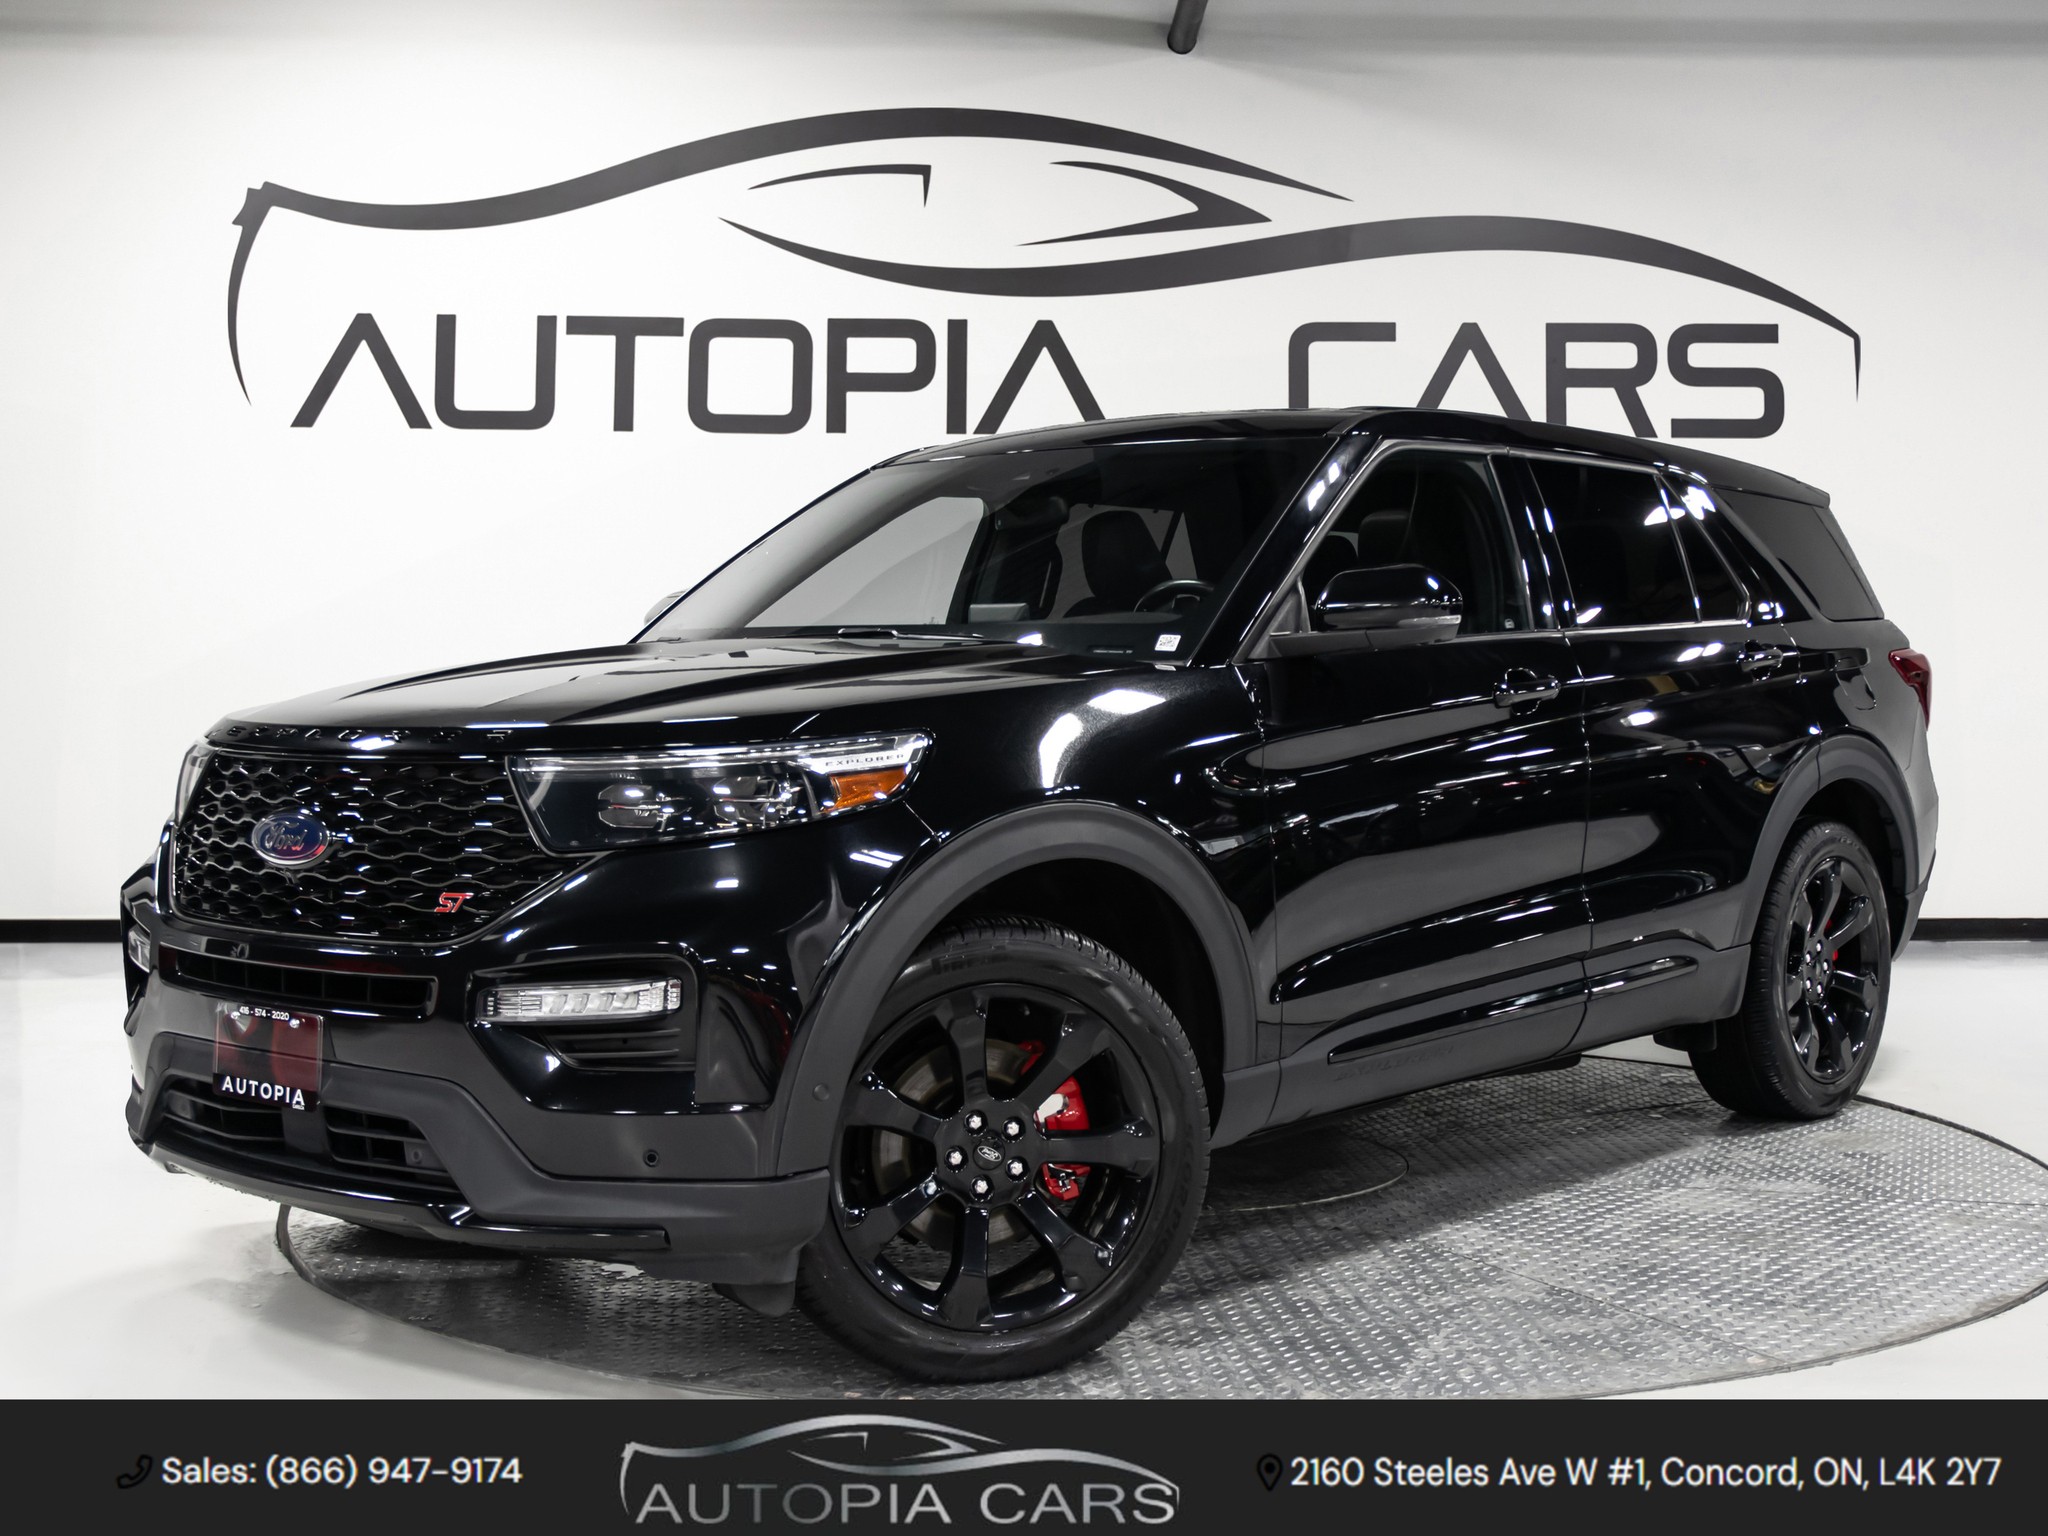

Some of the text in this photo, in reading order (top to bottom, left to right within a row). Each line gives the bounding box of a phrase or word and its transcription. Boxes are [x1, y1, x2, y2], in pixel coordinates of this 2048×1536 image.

[290, 313, 1785, 438] AUTOPIA CARS
[825, 754, 904, 767] EXPLORER
[263, 820, 305, 850] Ford
[434, 892, 474, 912] ST
[271, 1010, 290, 1021] 2020
[222, 1075, 305, 1107] AUTOPIA
